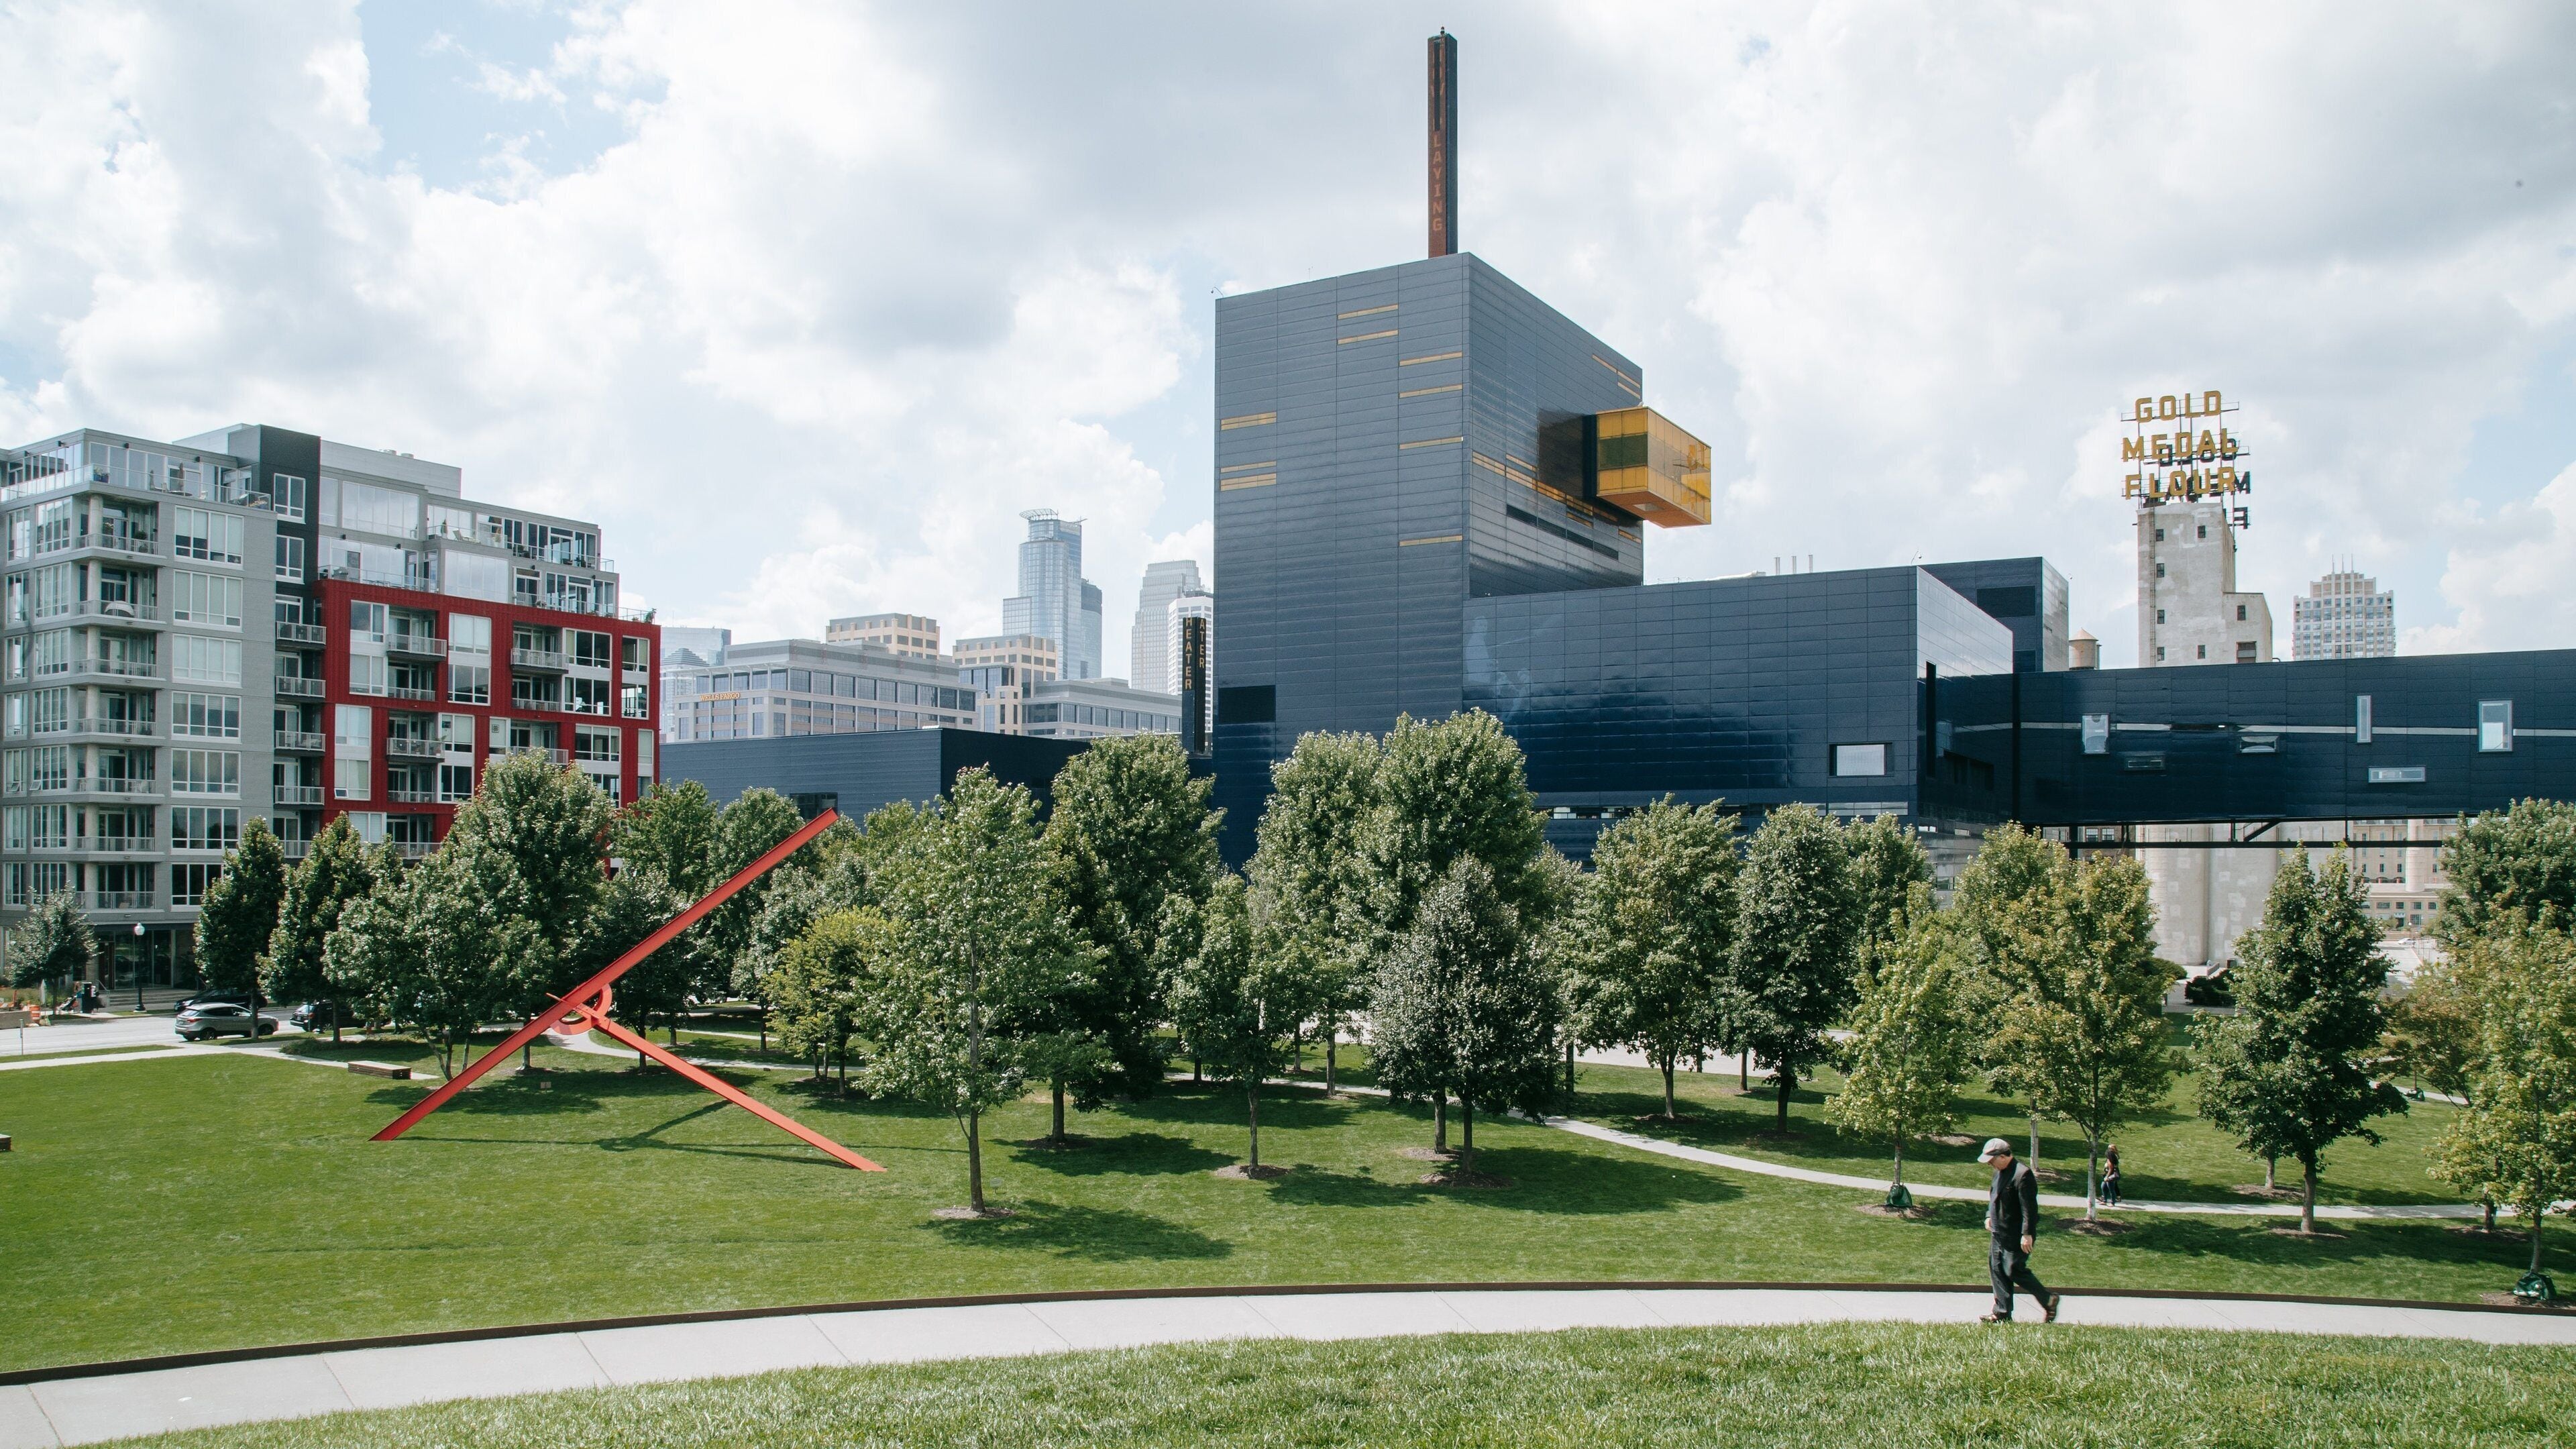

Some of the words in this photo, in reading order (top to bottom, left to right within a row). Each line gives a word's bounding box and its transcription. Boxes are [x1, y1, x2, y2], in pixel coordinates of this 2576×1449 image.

[1432, 117, 1443, 231] LAYING
[2135, 390, 2222, 423] GOLD
[2122, 427, 2239, 462] MEDAL
[2125, 466, 2236, 500] FLOUR
[700, 694, 720, 702] WELLS
[719, 692, 741, 700] FARGO
